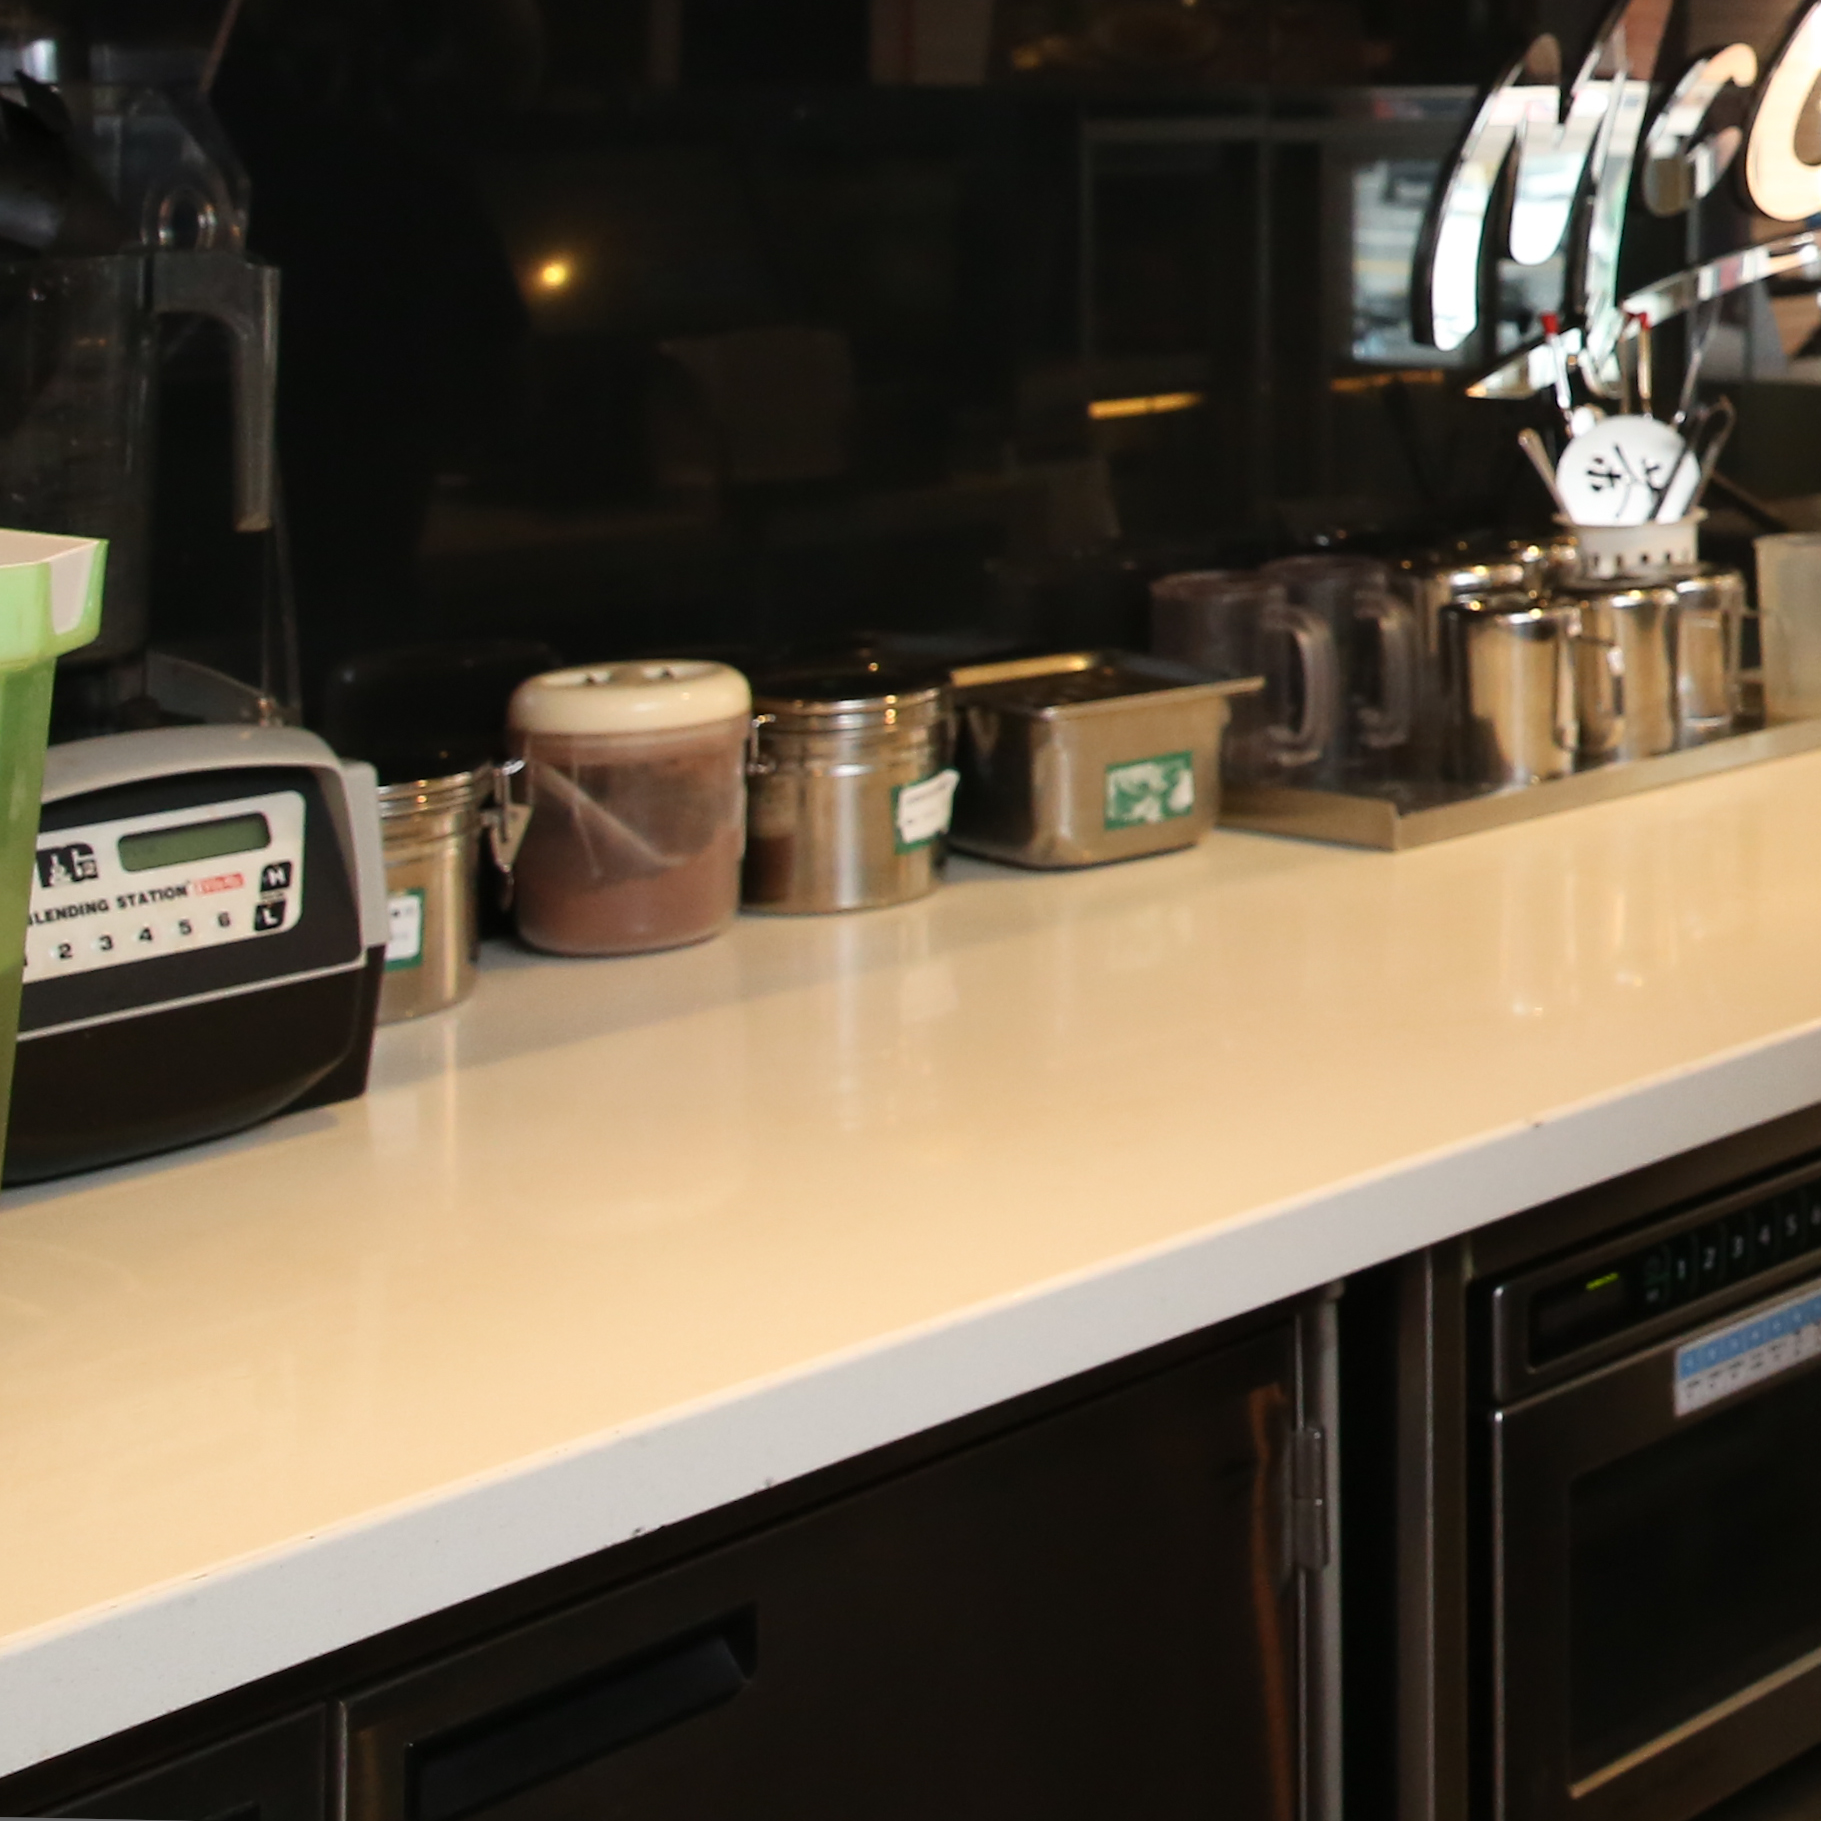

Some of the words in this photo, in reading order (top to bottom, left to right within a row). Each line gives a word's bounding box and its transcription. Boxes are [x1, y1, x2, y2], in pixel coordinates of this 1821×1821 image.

[28, 898, 110, 926] LENDING
[116, 882, 188, 910] STATION
[262, 907, 279, 926] L
[56, 942, 73, 960] 2
[99, 934, 115, 951] 3
[138, 927, 153, 943] 4
[178, 919, 193, 936] 5
[216, 911, 231, 927] 6
